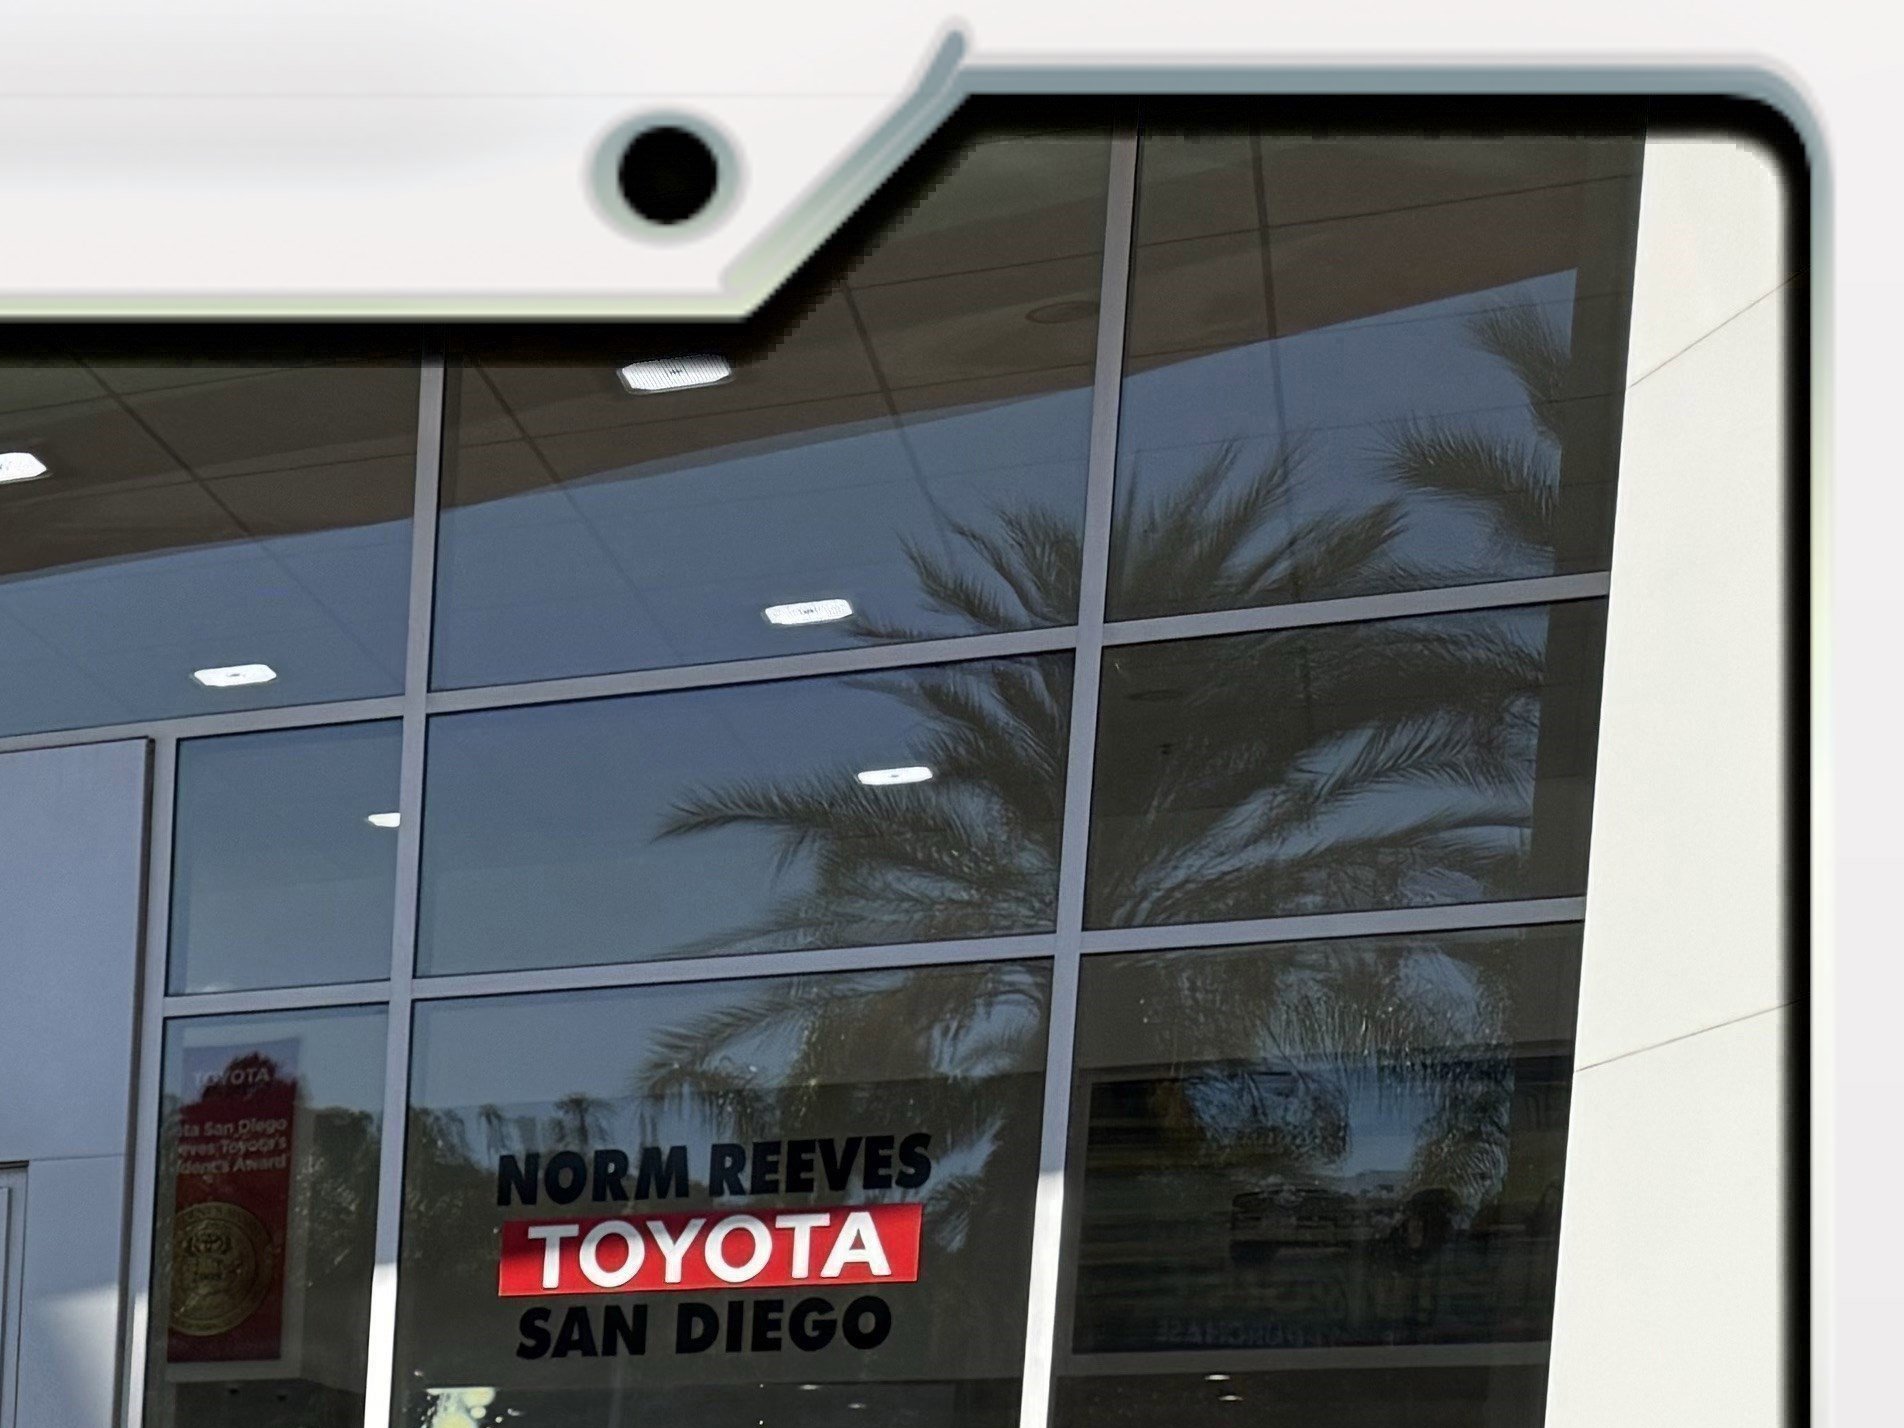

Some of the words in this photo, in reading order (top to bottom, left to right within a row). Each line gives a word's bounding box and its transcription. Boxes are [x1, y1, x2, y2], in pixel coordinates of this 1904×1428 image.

[497, 1144, 690, 1206] NORM
[708, 1132, 932, 1197] REEVES
[527, 1211, 892, 1290] TOYOTA
[516, 1303, 648, 1360] SAN
[675, 1295, 892, 1354] DIEGO
